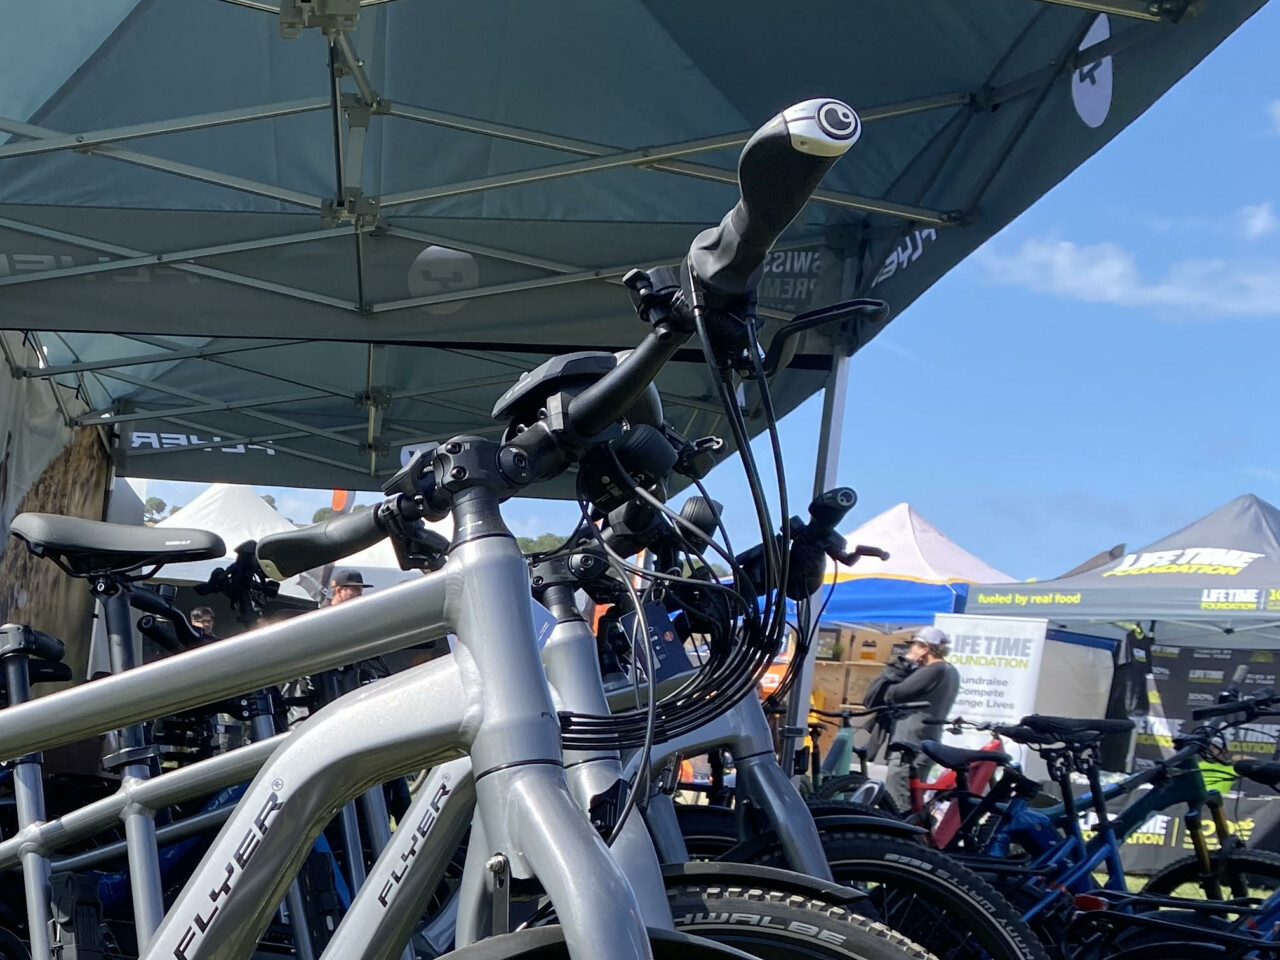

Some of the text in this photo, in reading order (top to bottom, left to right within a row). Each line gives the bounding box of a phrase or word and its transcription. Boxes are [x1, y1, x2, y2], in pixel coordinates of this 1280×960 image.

[978, 593, 1081, 606] fueled by real food
[984, 636, 1033, 657] TIME
